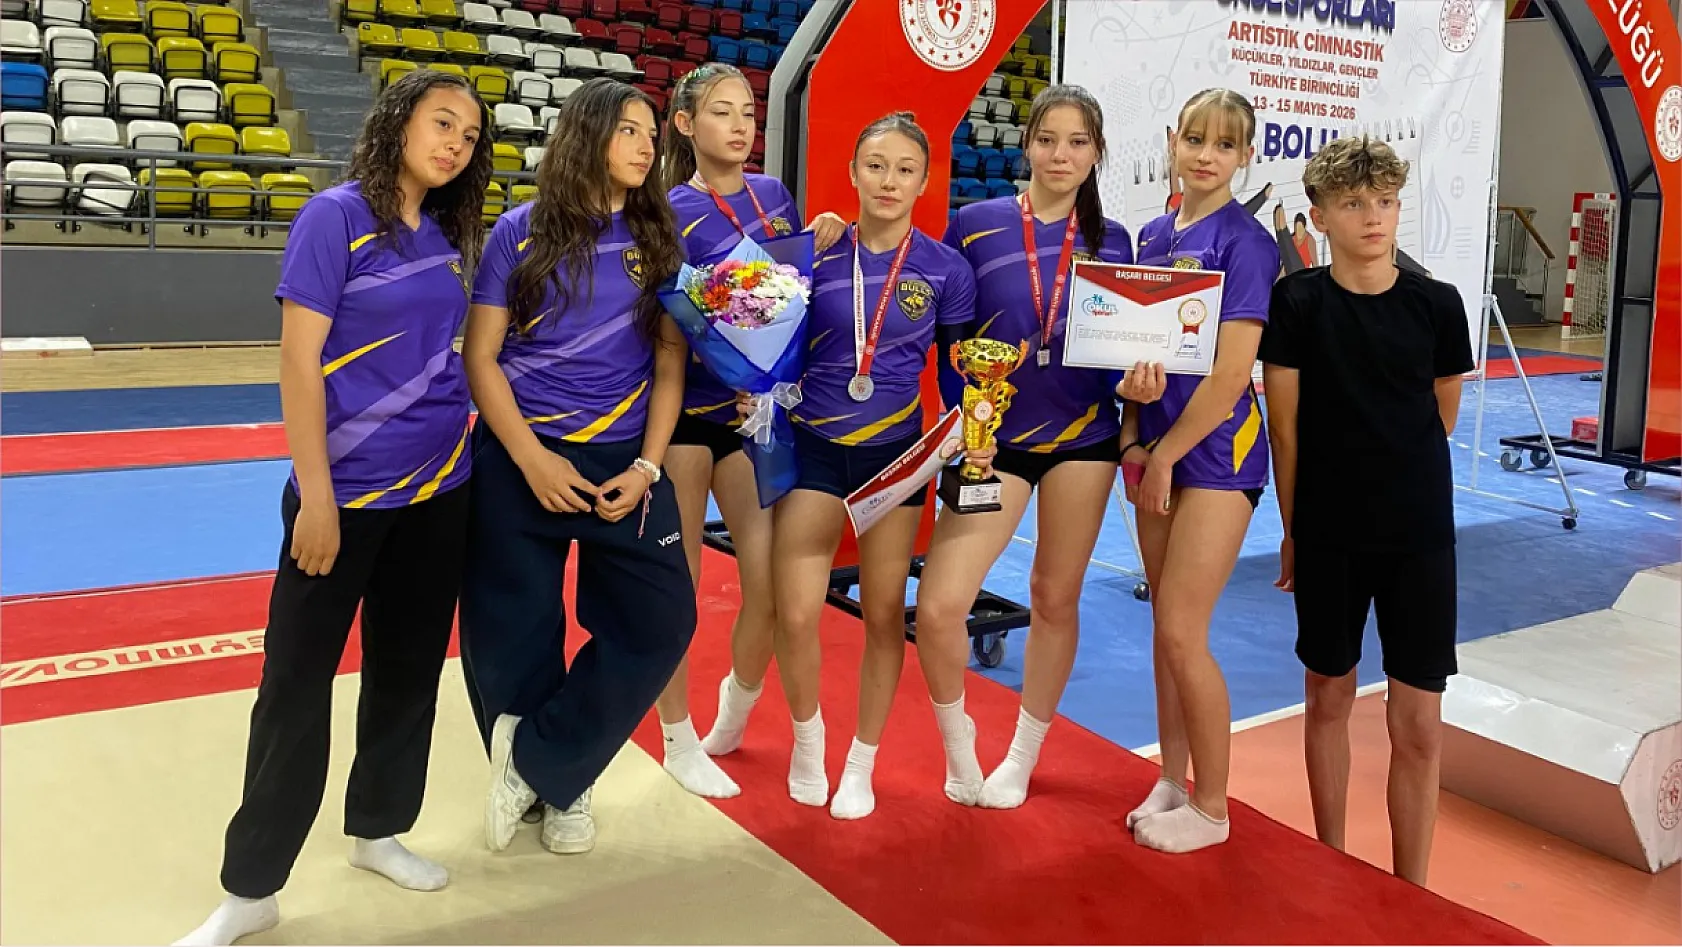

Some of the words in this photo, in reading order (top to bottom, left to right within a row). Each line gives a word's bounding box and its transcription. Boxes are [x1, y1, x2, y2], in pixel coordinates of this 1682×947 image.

[1228, 20, 1300, 49] ARTİSTİK
[1304, 29, 1385, 62] CİMNASTİK
[1231, 47, 1286, 69] KÜÇÜKLER,
[1288, 55, 1337, 76] YILDIZLAR,
[1339, 64, 1379, 80] GENÇLER
[1249, 69, 1298, 91] TÜRKİYE
[1300, 76, 1360, 99] BİRİNCİLİĞİ
[1253, 95, 1267, 110] 13
[1276, 98, 1291, 112] 15
[1293, 100, 1328, 117] MAYIS
[1330, 104, 1356, 120] 2026
[657, 531, 681, 548] VOID
